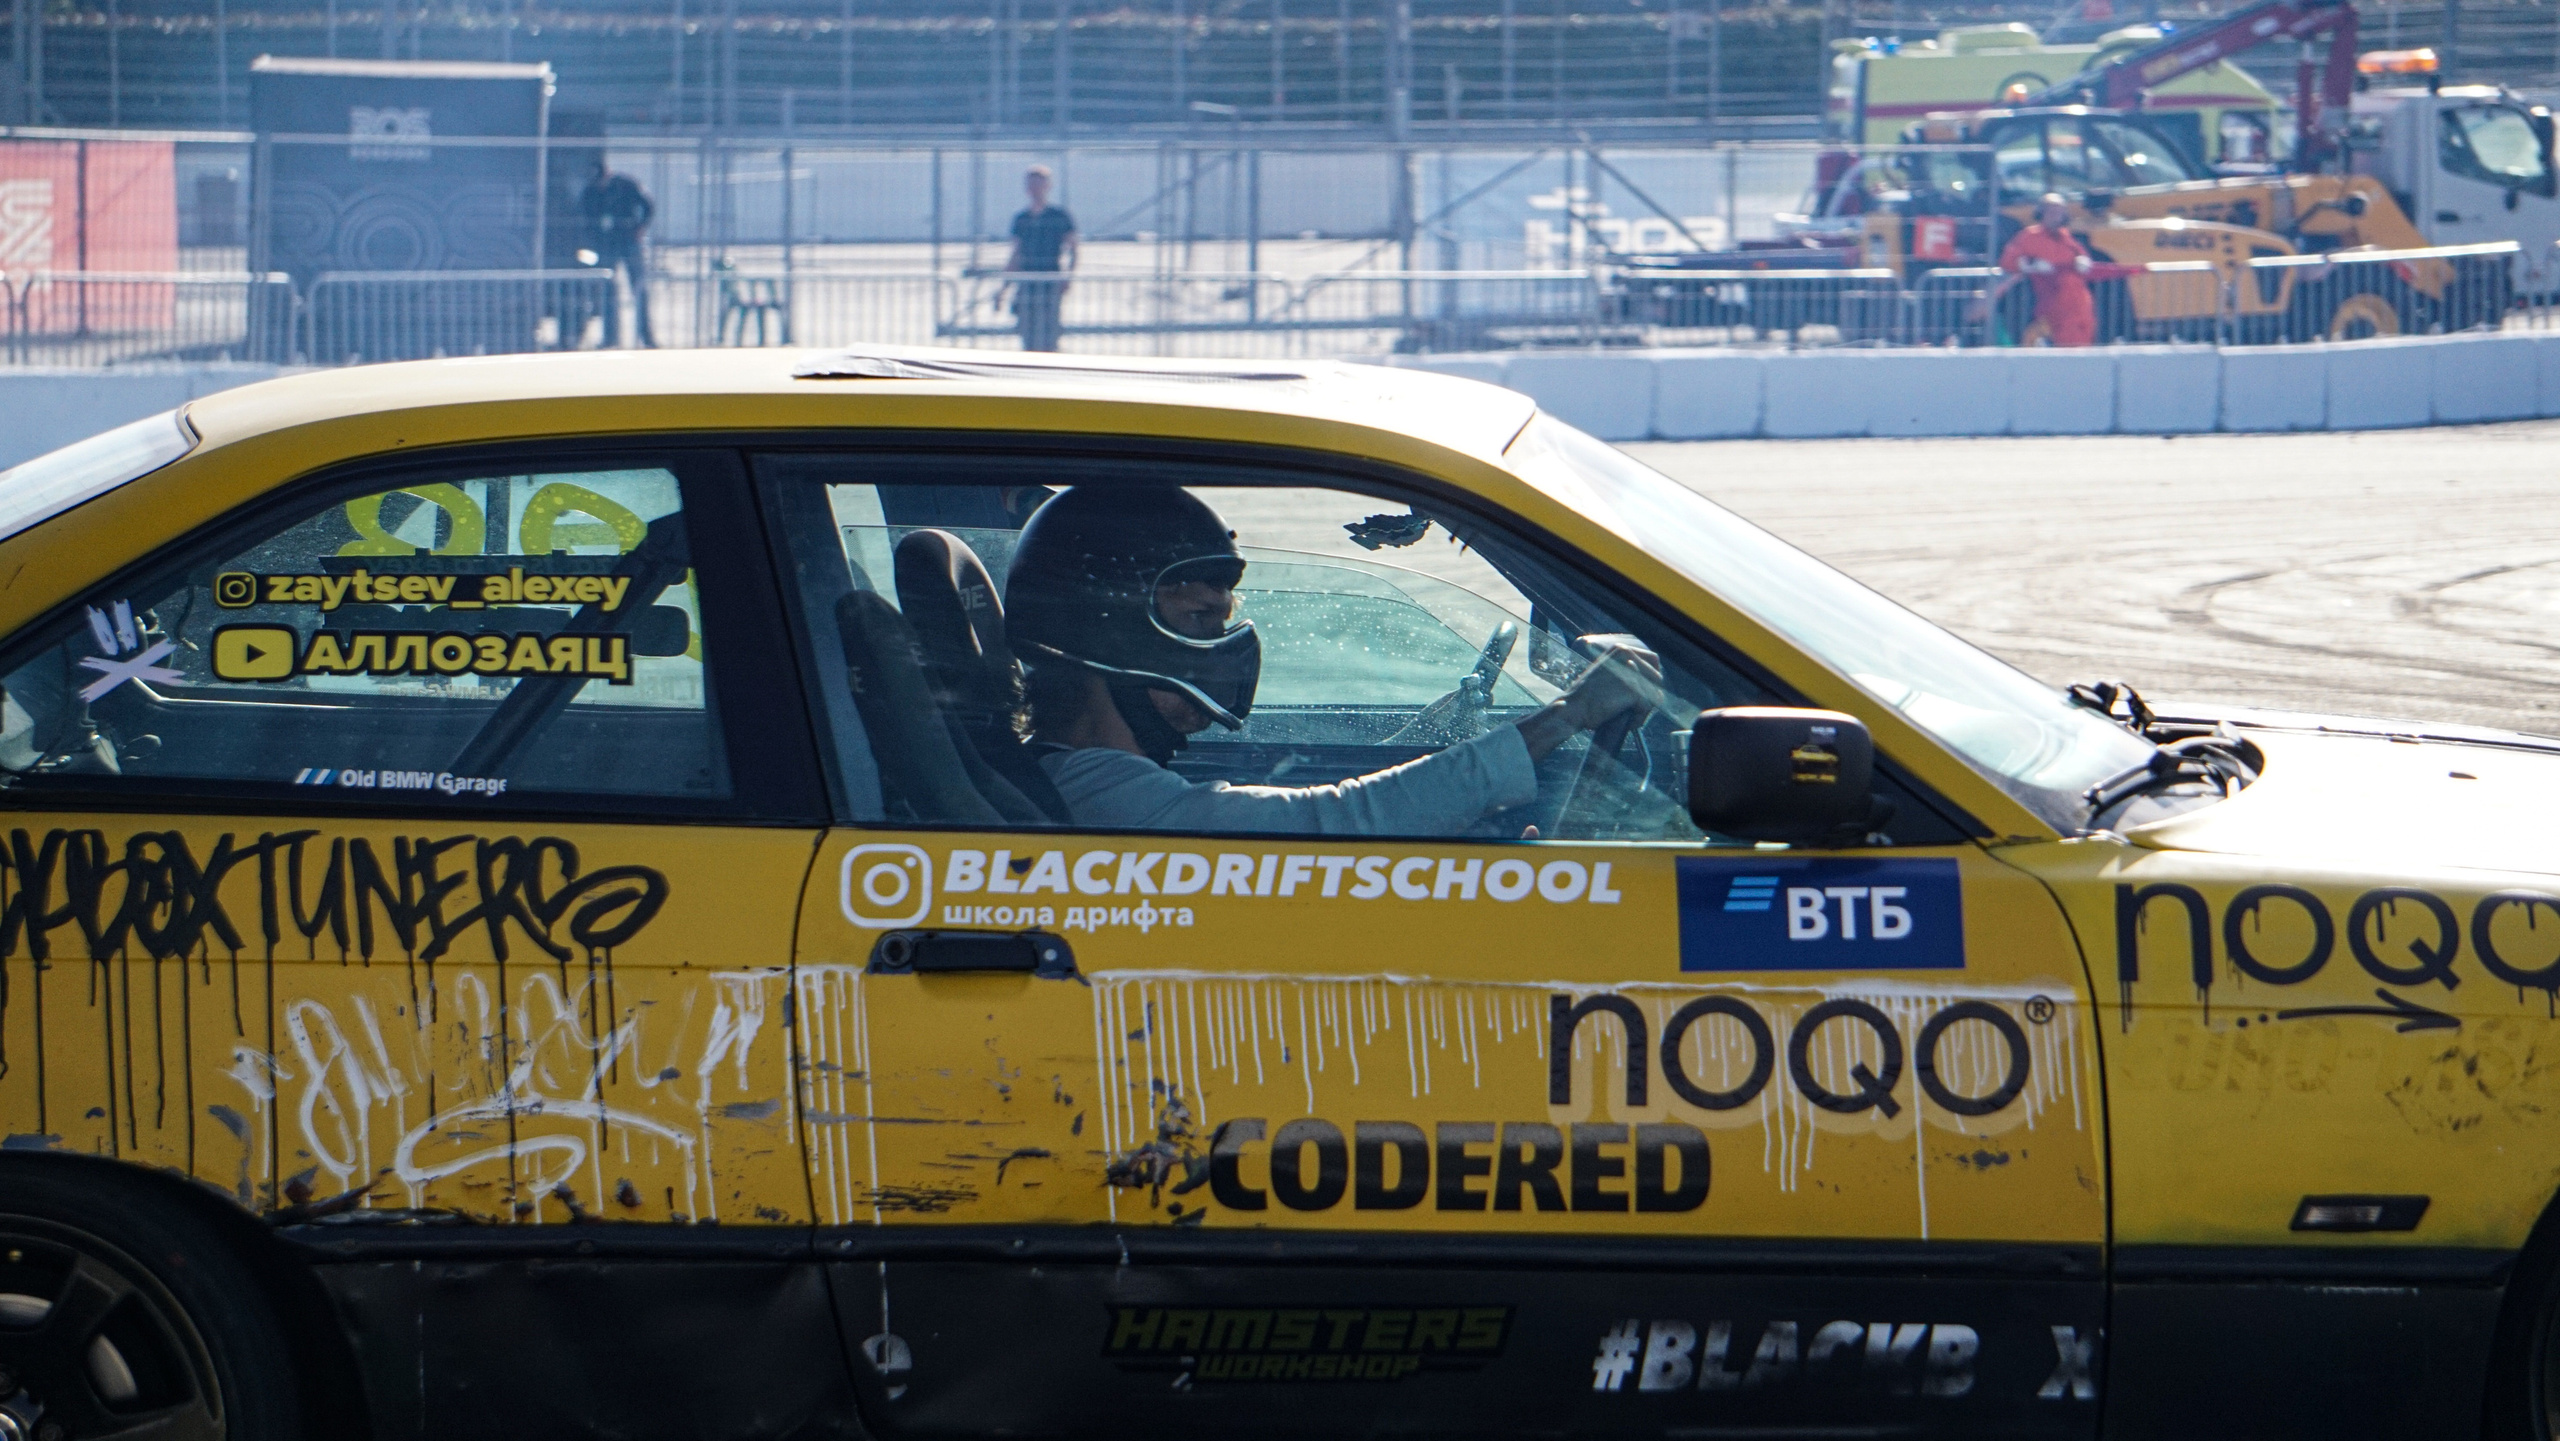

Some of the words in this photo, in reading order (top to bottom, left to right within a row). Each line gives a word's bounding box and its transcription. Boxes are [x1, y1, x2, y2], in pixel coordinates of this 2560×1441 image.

[1923, 222, 1950, 254] F
[268, 568, 631, 612] zaytsev_alexey
[305, 634, 628, 683] АЛЛОЗАЯЦ
[341, 770, 375, 788] Old
[382, 771, 434, 790] BMW
[943, 849, 1622, 904] BLACKDRIFTSCHOOL
[943, 904, 1055, 928] школа
[1063, 901, 1194, 933] дрифта
[1787, 887, 1912, 940] ВТБ
[1209, 1118, 1711, 1213] CODERED
[1112, 1307, 1508, 1350] HAMSTERS
[1199, 1354, 1420, 1380] WORKSHOP
